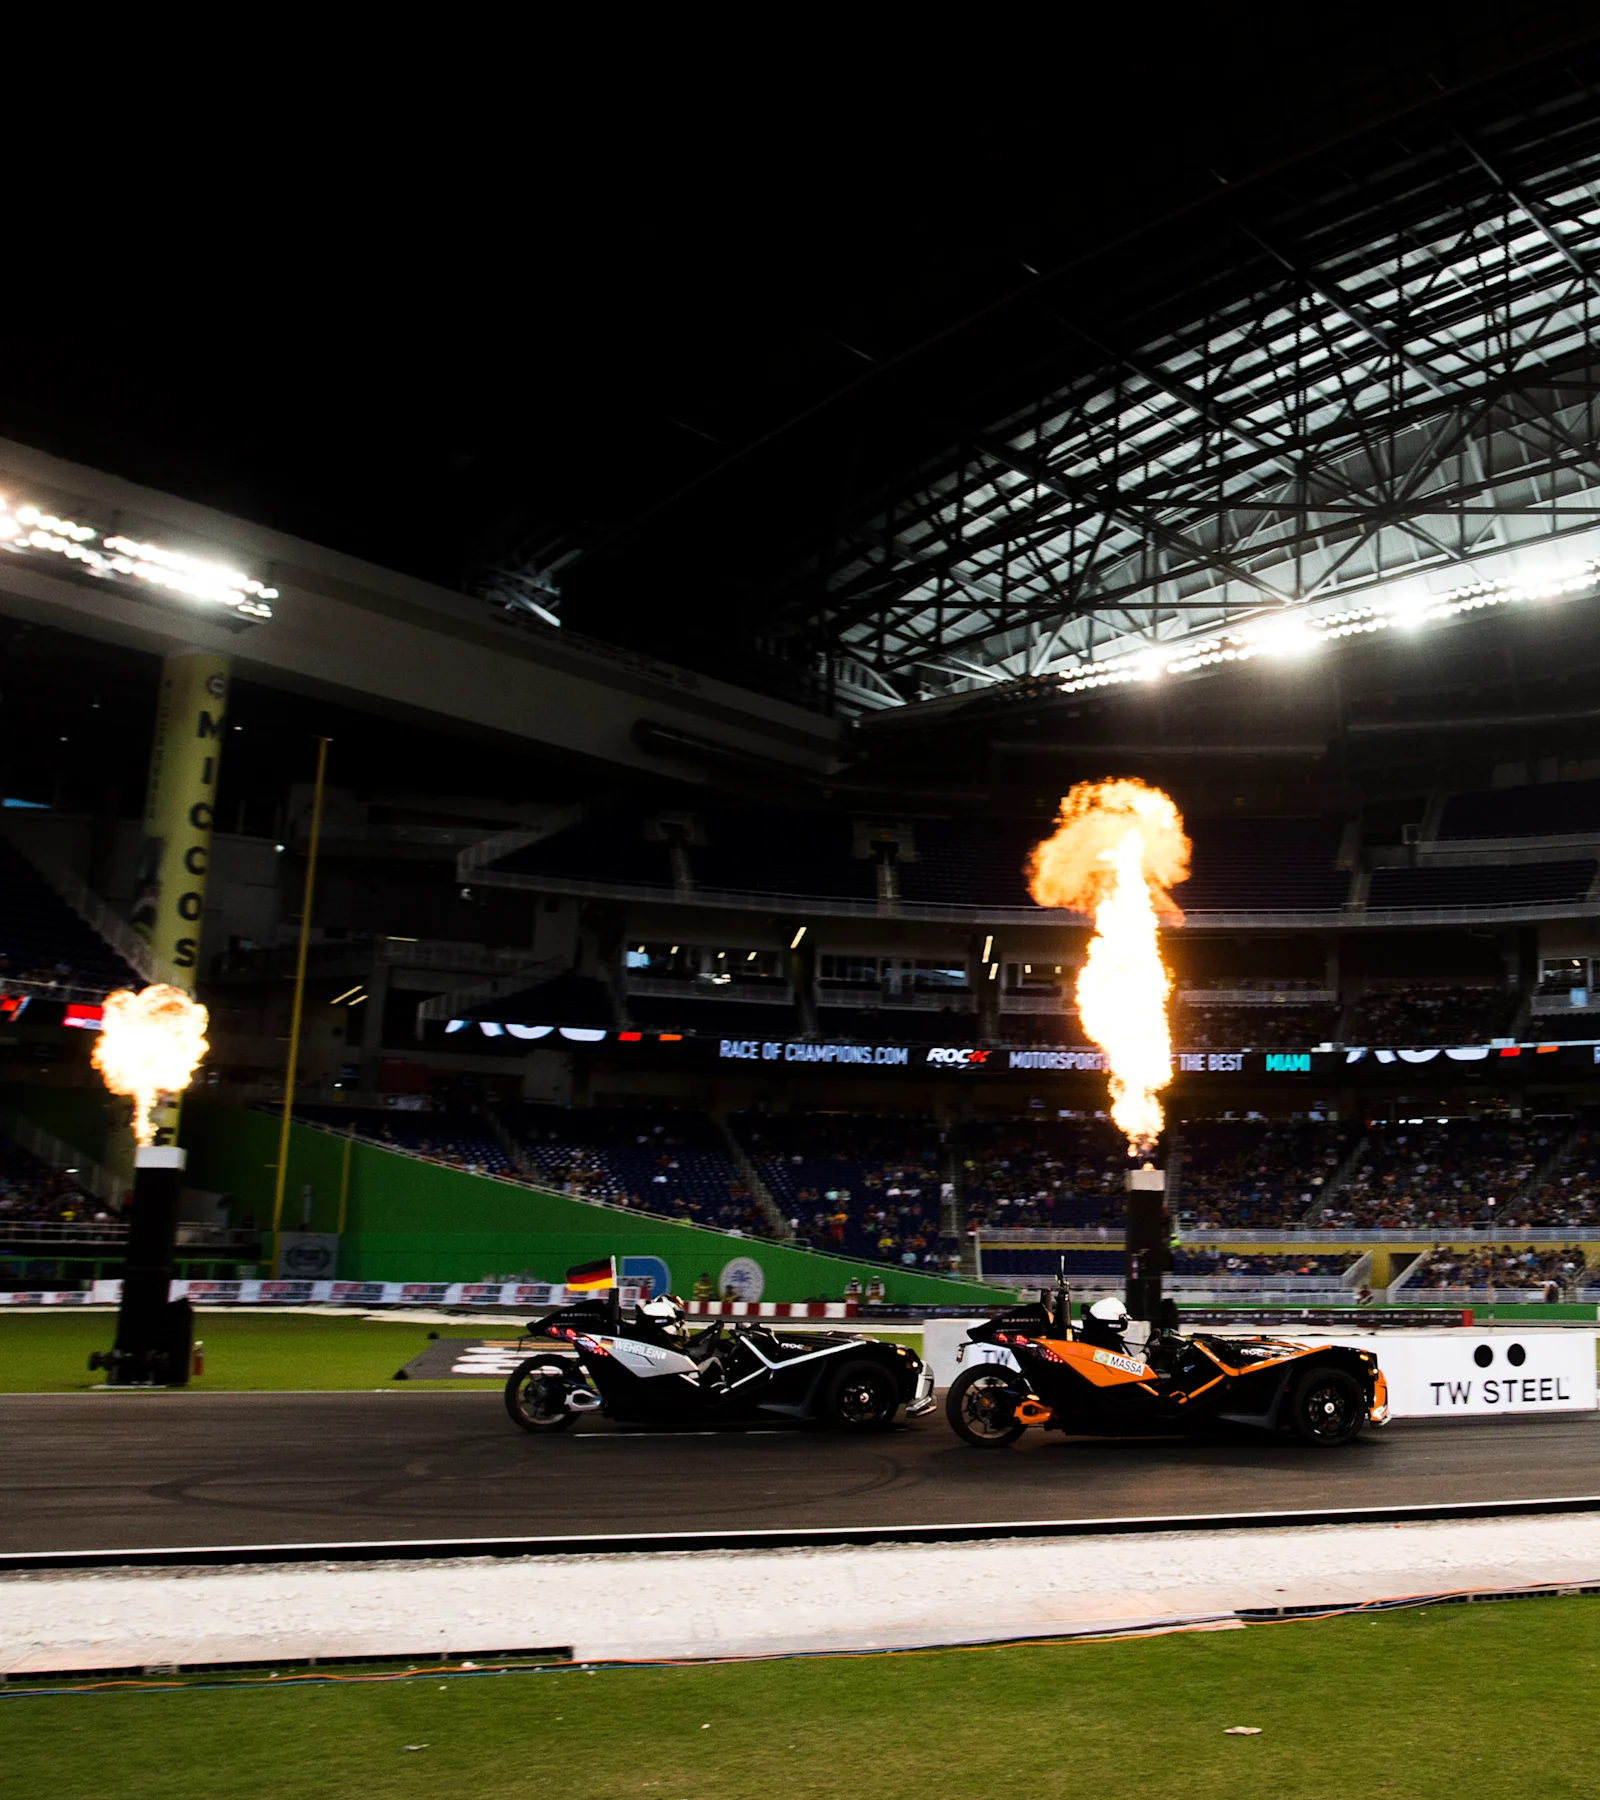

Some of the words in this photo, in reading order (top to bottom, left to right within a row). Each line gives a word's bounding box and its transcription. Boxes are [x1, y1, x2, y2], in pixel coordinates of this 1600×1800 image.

[719, 1040, 760, 1059] RACE
[762, 1042, 783, 1060] OF
[785, 1043, 909, 1065] CHAMPIONS.COM
[1180, 1054, 1206, 1071] THE
[1208, 1054, 1245, 1071] BEST
[1266, 1053, 1310, 1072] MIAMI
[614, 1340, 662, 1360] WEHRLEIN
[983, 1350, 1011, 1365] TW
[1110, 1356, 1143, 1374] MASSA
[1430, 1381, 1472, 1405] TW
[1484, 1378, 1570, 1404] STEEL
